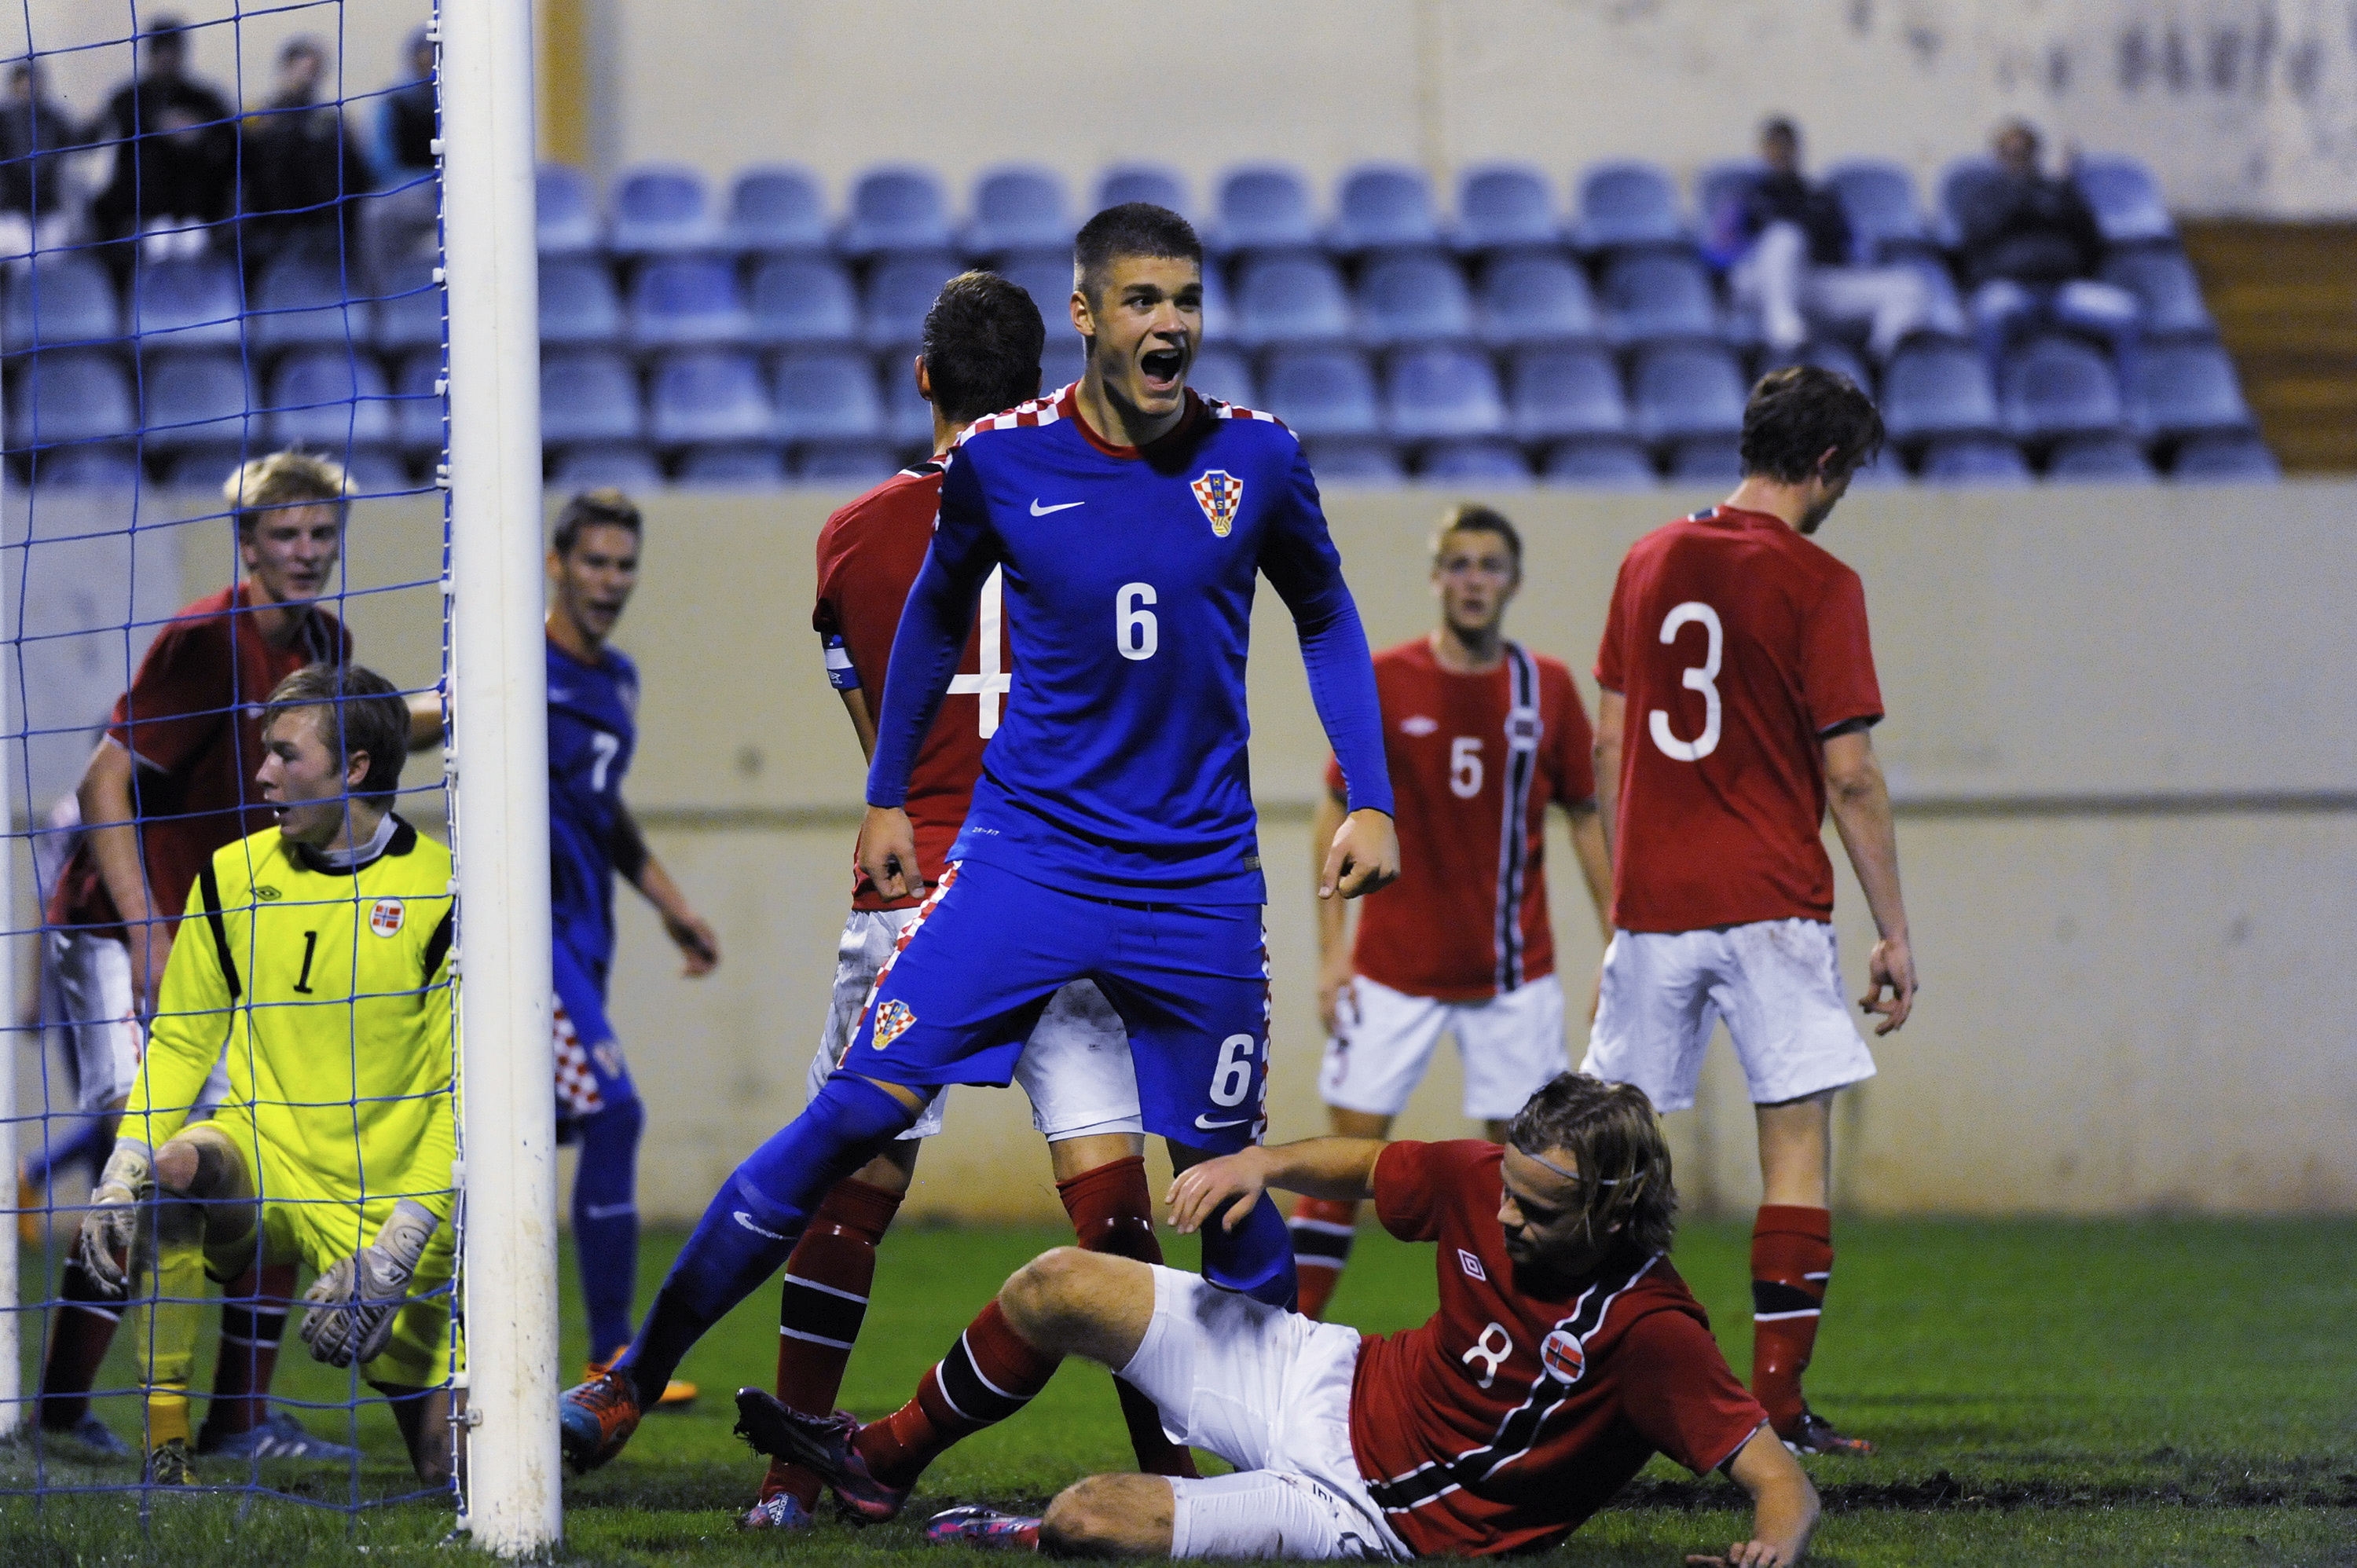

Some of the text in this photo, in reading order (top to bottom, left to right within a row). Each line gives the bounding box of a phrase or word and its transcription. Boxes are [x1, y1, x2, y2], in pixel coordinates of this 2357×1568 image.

[946, 562, 1012, 738] 4
[1116, 582, 1158, 661] 6
[1649, 601, 1723, 761] 3
[592, 731, 619, 792] 7
[1450, 737, 1484, 798] 5
[293, 931, 317, 994] 1
[1210, 1034, 1255, 1107] 6
[1462, 1321, 1513, 1389] 8
[774, 1493, 789, 1526] adidas
